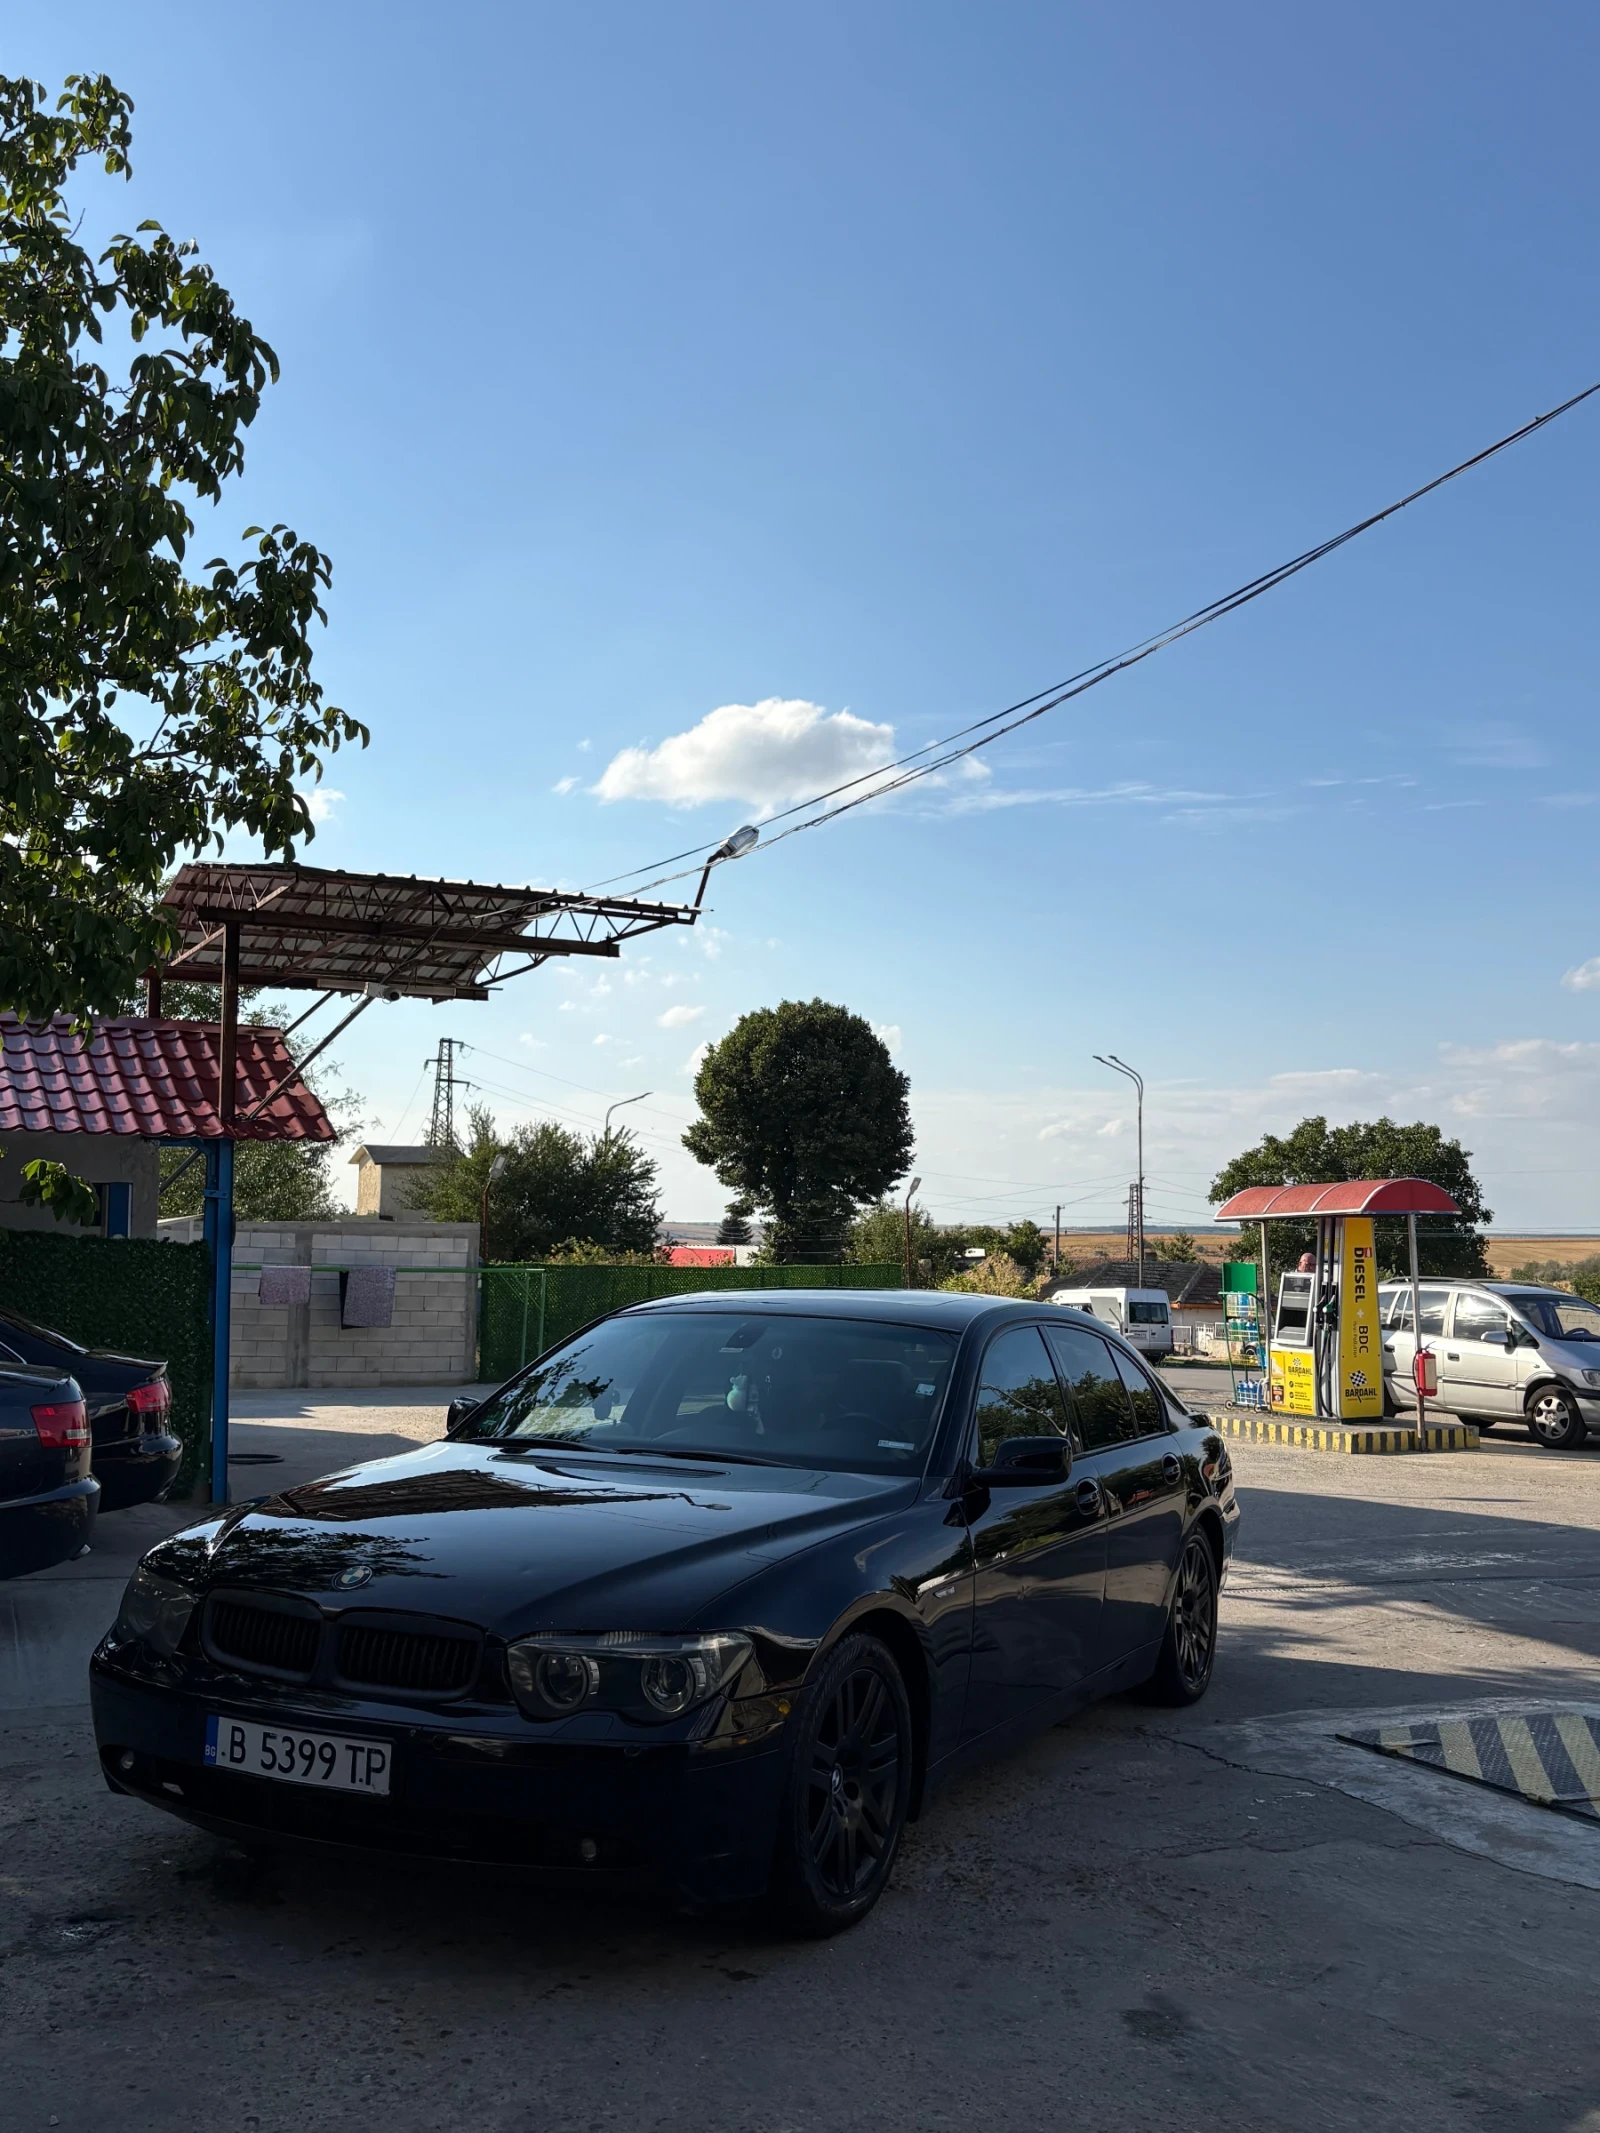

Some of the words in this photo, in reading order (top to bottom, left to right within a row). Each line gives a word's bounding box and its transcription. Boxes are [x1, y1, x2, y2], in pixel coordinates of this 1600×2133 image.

[1354, 1247, 1366, 1303] DIESEL
[1358, 1325, 1369, 1353] BDC
[1288, 1366, 1312, 1375] BARDAHL
[1345, 1388, 1377, 1397] BARDAHL
[205, 1744, 216, 1757] BG
[229, 1725, 246, 1764] B
[260, 1731, 337, 1780] 5399
